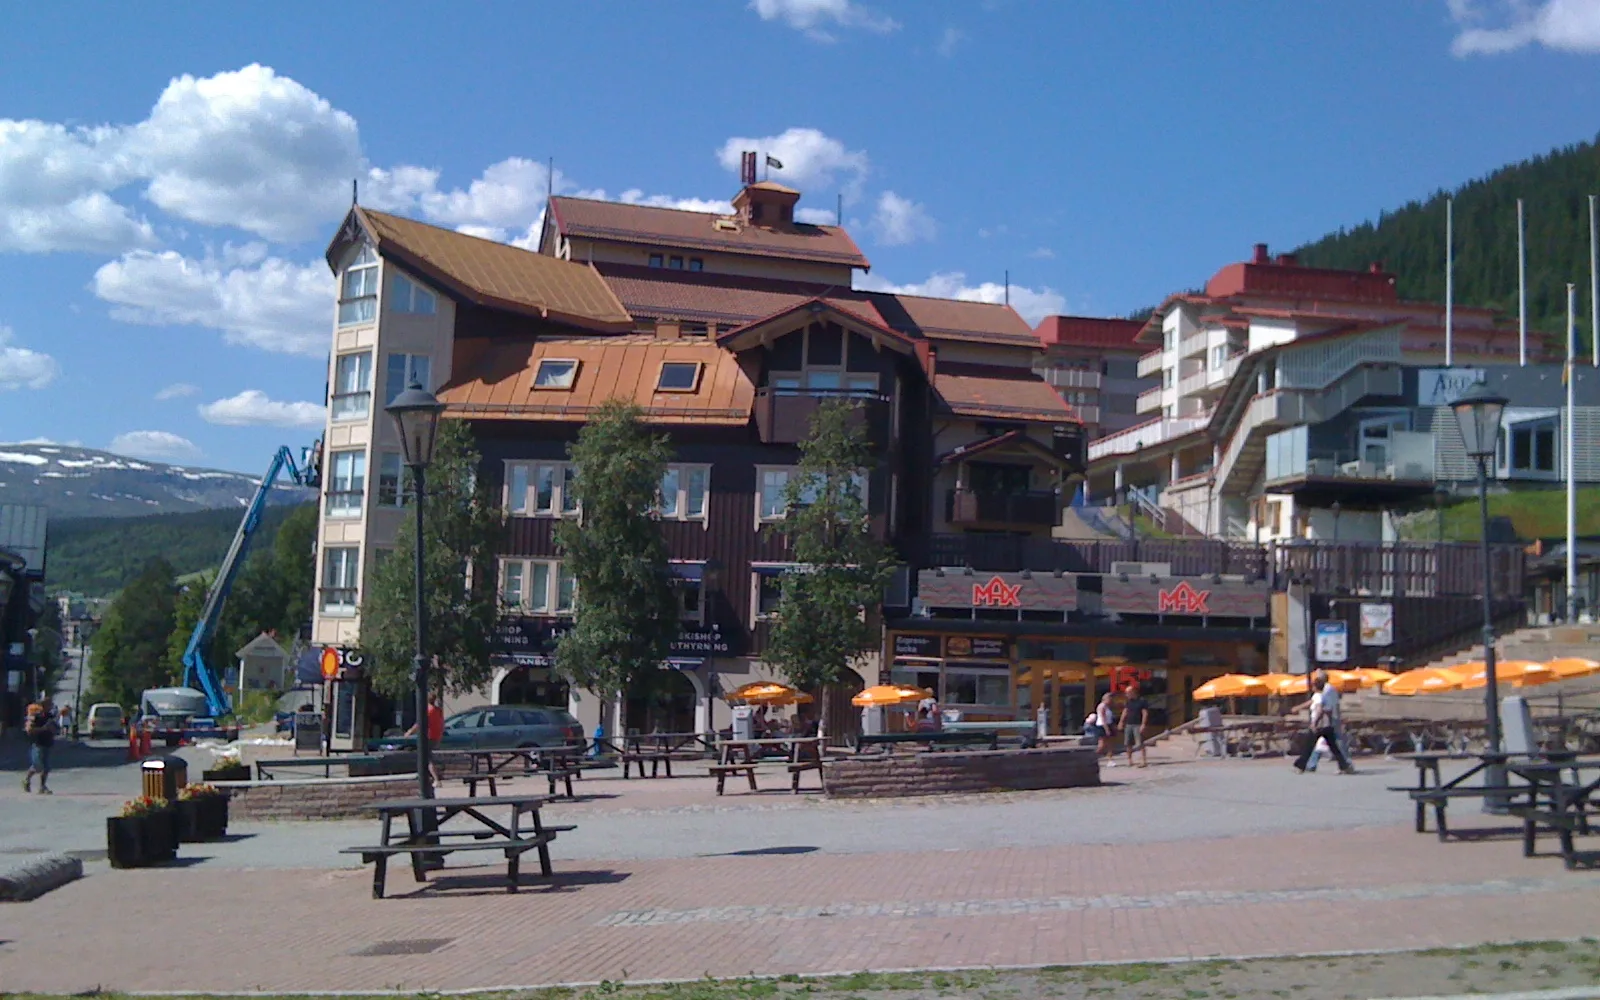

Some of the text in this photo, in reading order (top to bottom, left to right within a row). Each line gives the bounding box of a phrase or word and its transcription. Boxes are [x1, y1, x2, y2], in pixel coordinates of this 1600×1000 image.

[972, 575, 1023, 607] MAX
[1158, 580, 1211, 613] MAX
[669, 641, 729, 652] UTHYRNNG
